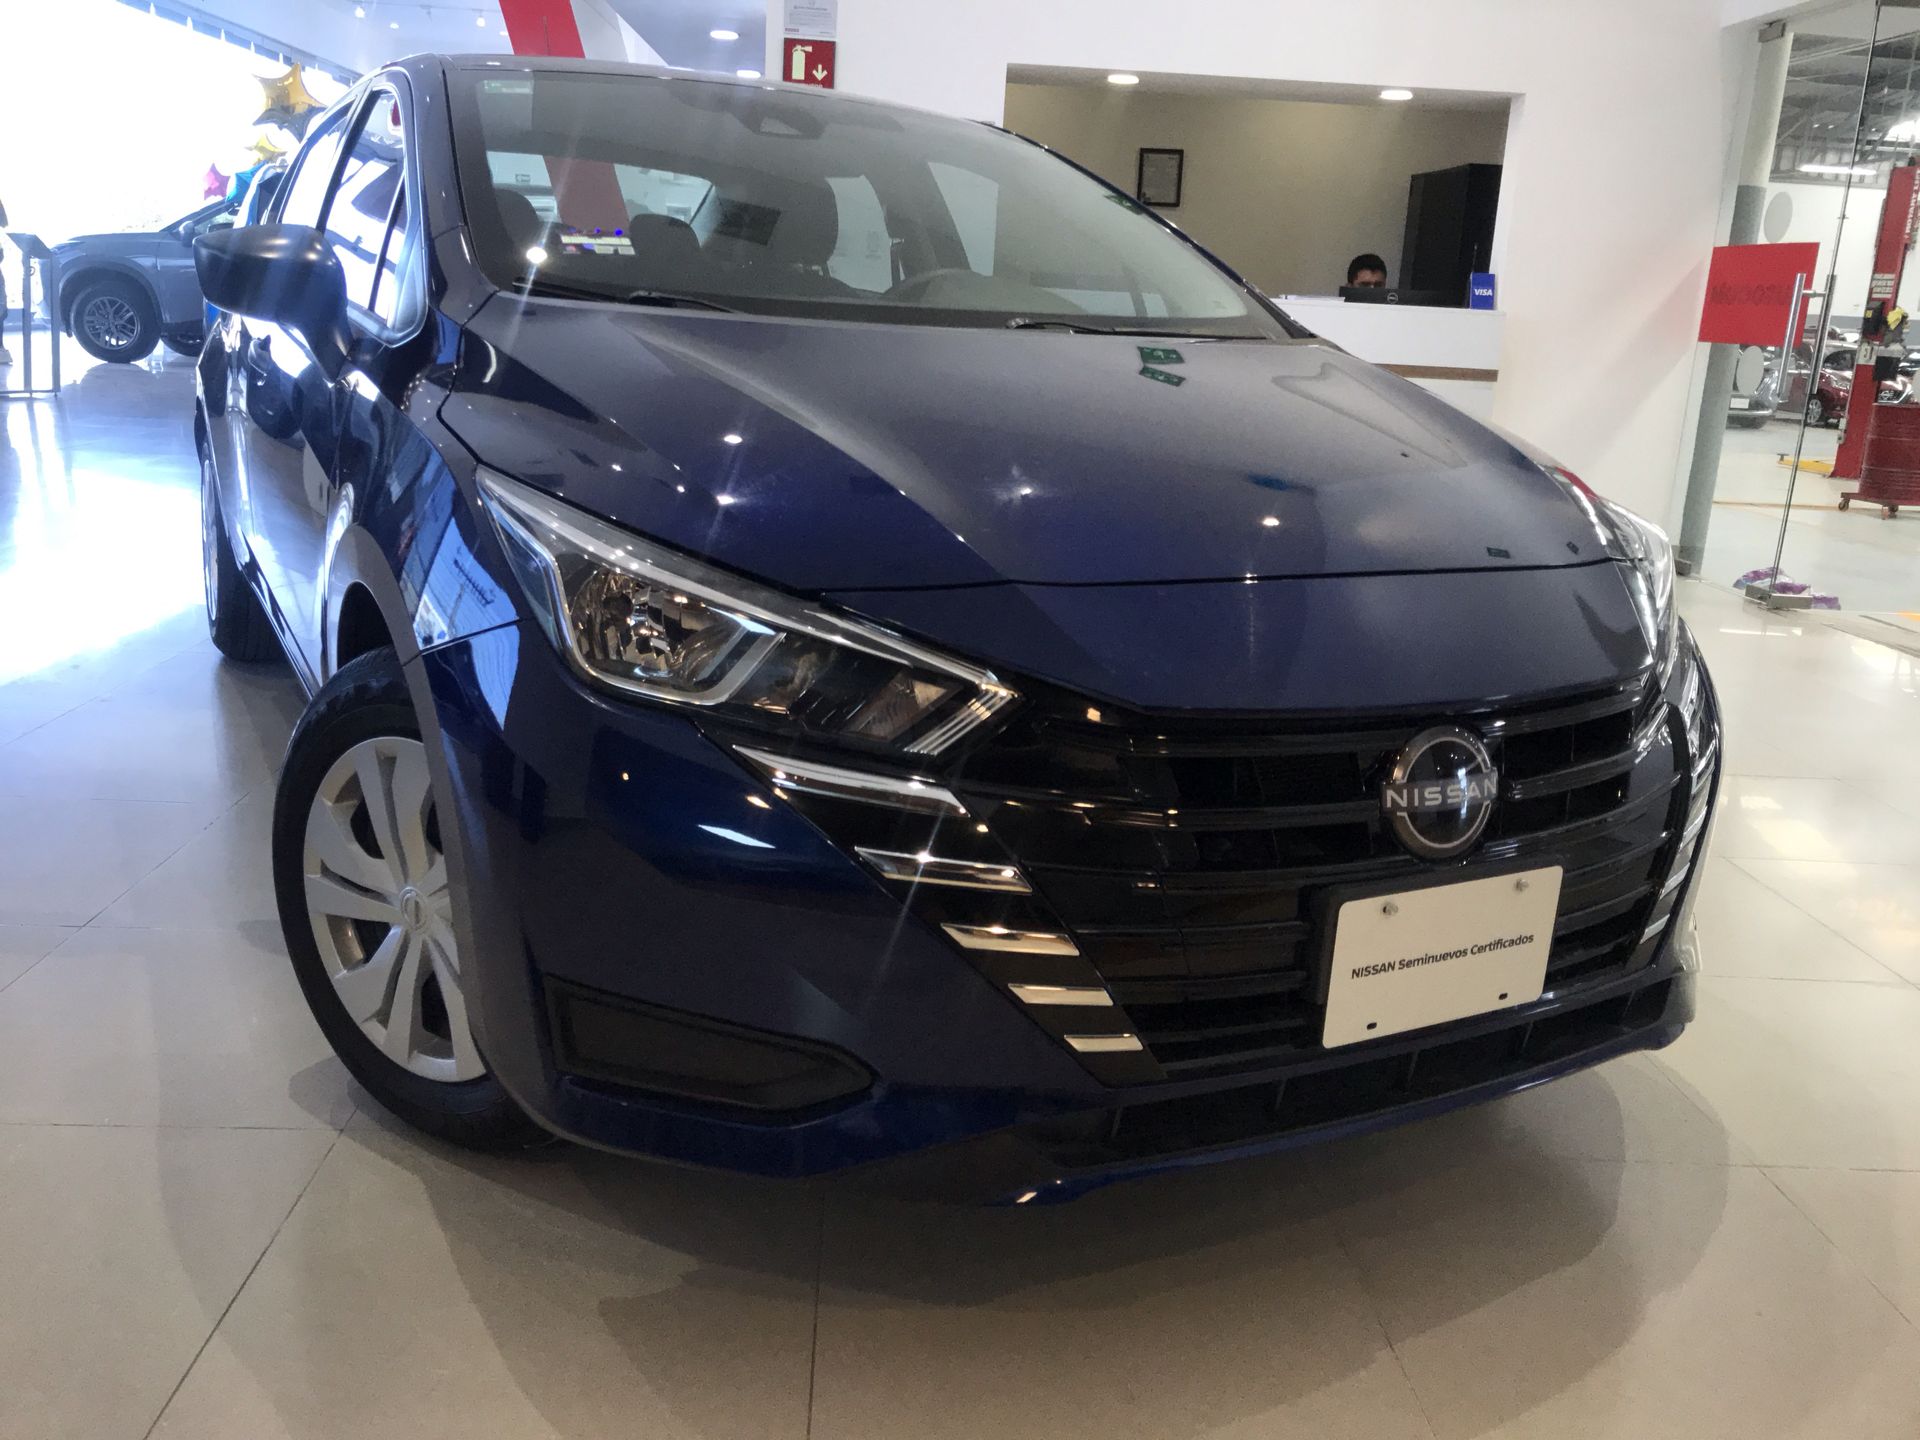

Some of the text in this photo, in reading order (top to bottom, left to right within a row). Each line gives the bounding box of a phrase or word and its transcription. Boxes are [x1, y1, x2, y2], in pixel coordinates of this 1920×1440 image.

[1386, 778, 1498, 808] NISSAN
[1351, 934, 1535, 979] NISSAN Seminuevos Certificados
